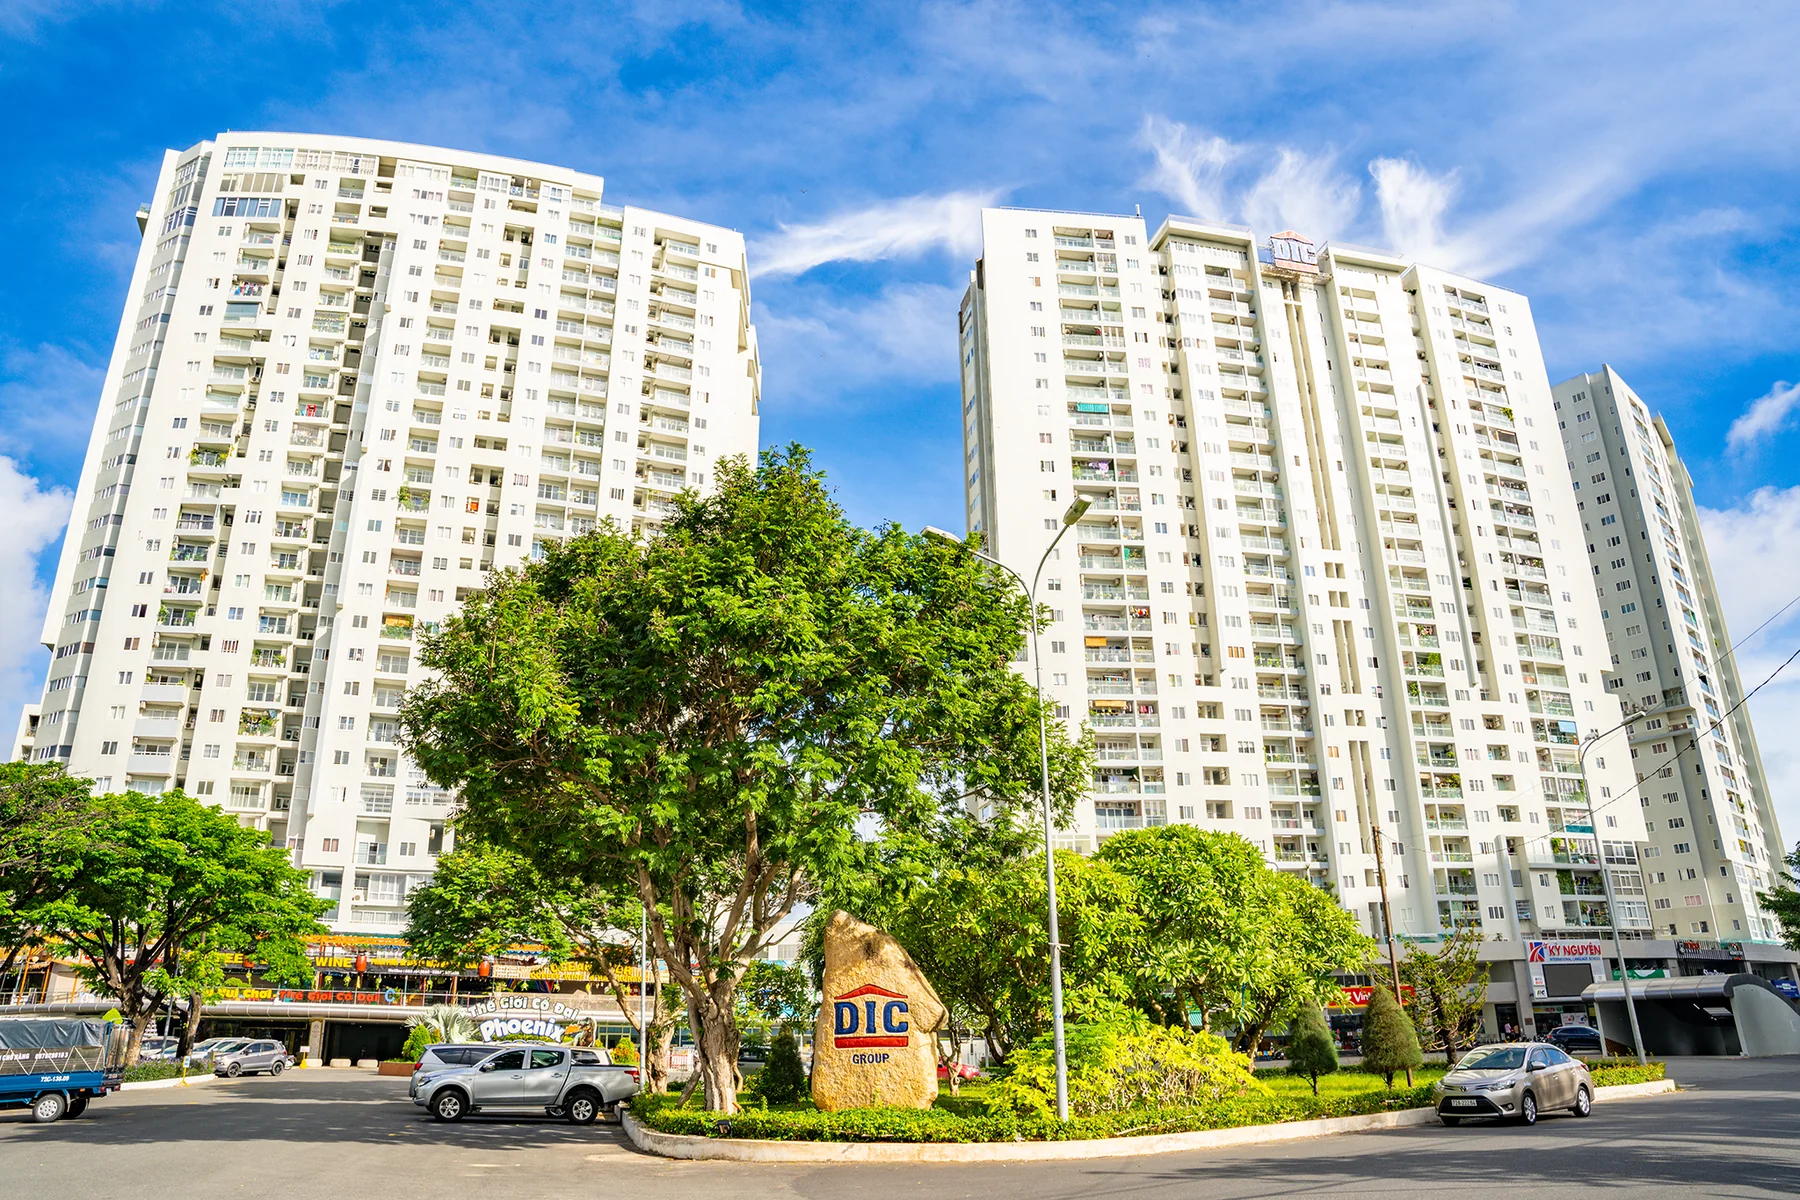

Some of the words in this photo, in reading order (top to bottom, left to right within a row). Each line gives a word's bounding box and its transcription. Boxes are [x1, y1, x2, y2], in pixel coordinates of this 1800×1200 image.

[1271, 238, 1317, 265] DIC
[1563, 942, 1601, 955] NGUYÊN
[315, 956, 353, 968] WINE
[834, 1001, 909, 1035] DIC
[480, 1017, 566, 1043] Phoenix
[852, 1053, 890, 1064] GROUP
